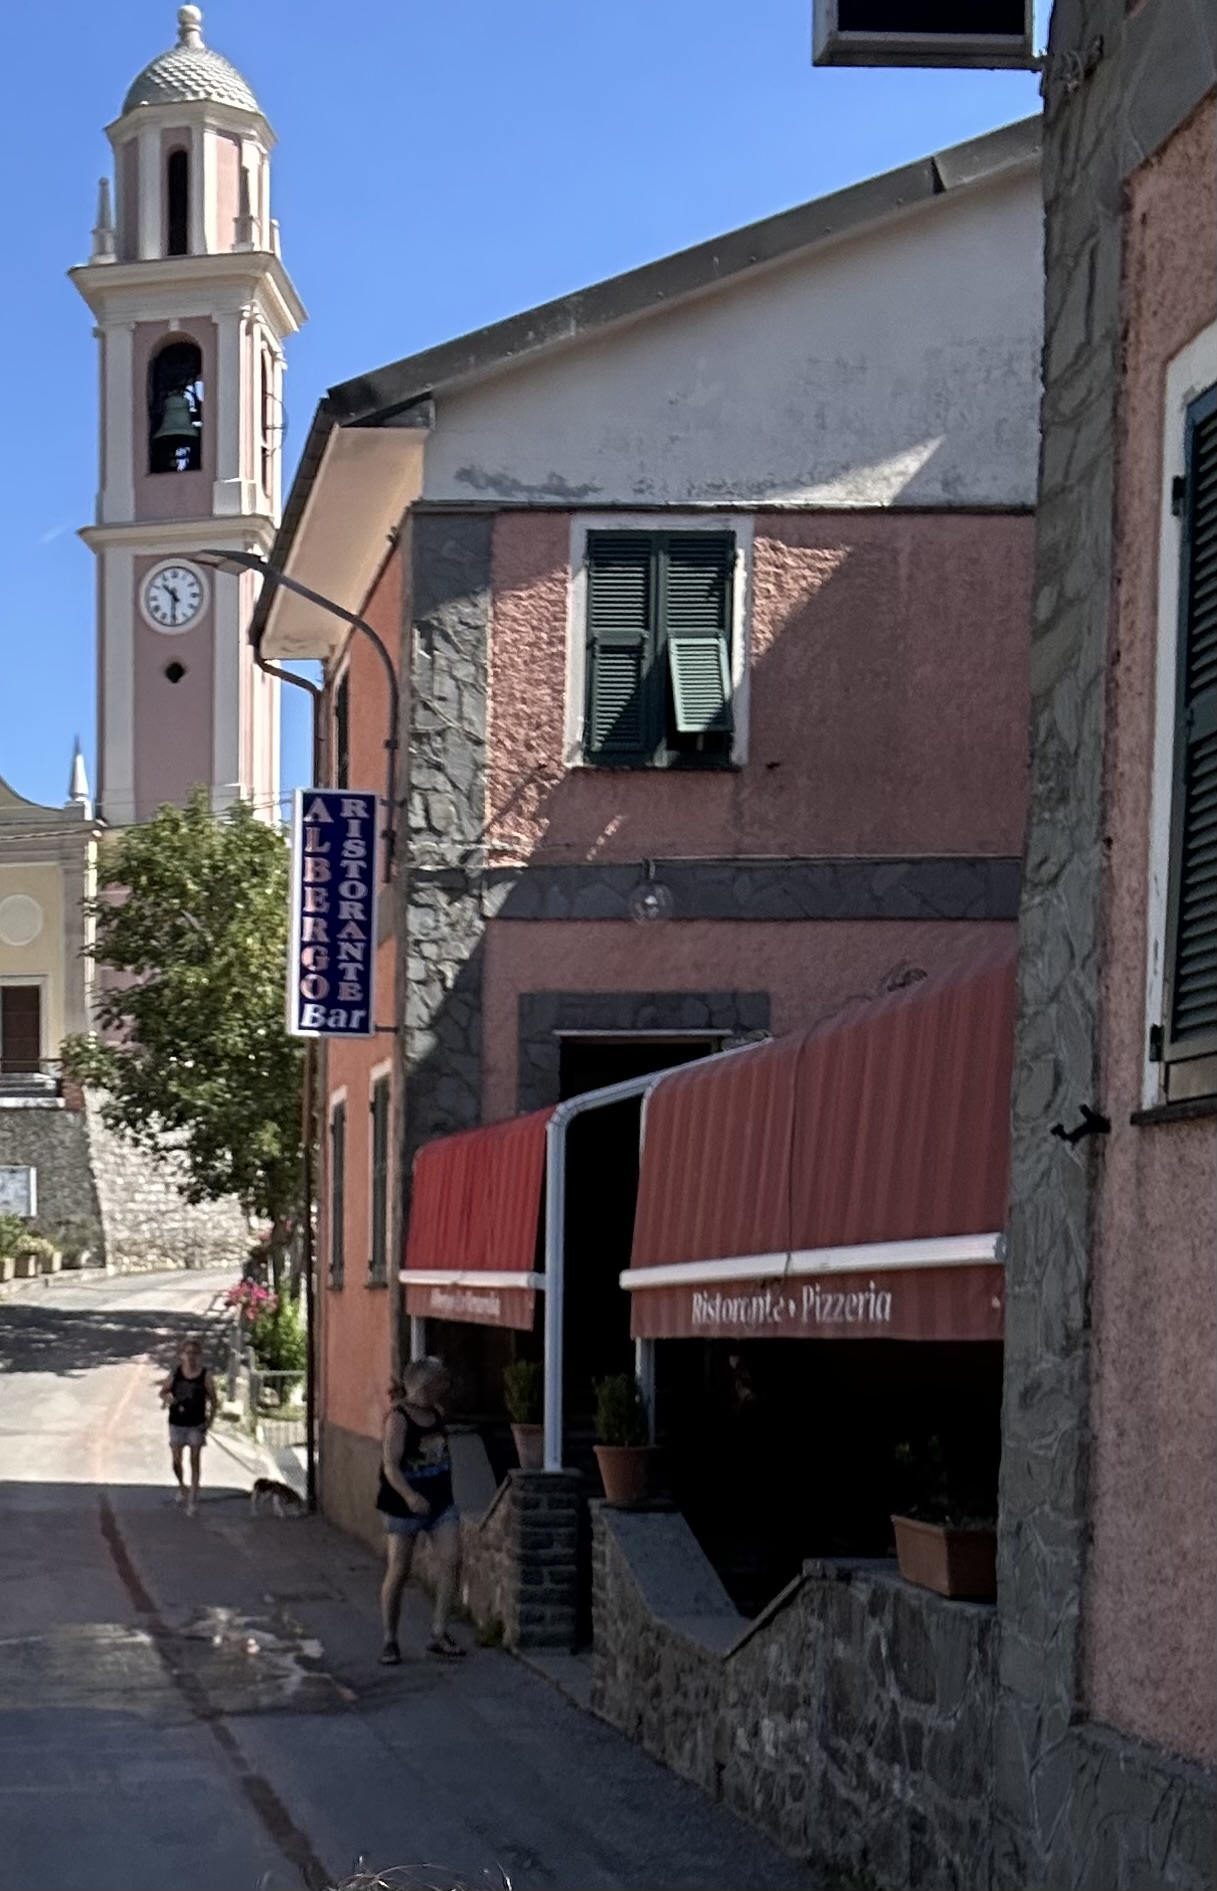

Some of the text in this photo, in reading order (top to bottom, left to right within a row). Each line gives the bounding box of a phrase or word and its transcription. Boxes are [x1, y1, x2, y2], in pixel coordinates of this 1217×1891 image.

[301, 798, 334, 1000] ALBERGO
[337, 799, 370, 1001] RISTORANTE
[301, 1003, 367, 1029] Bar
[691, 1281, 893, 1325] Ristorante Pizzeria
